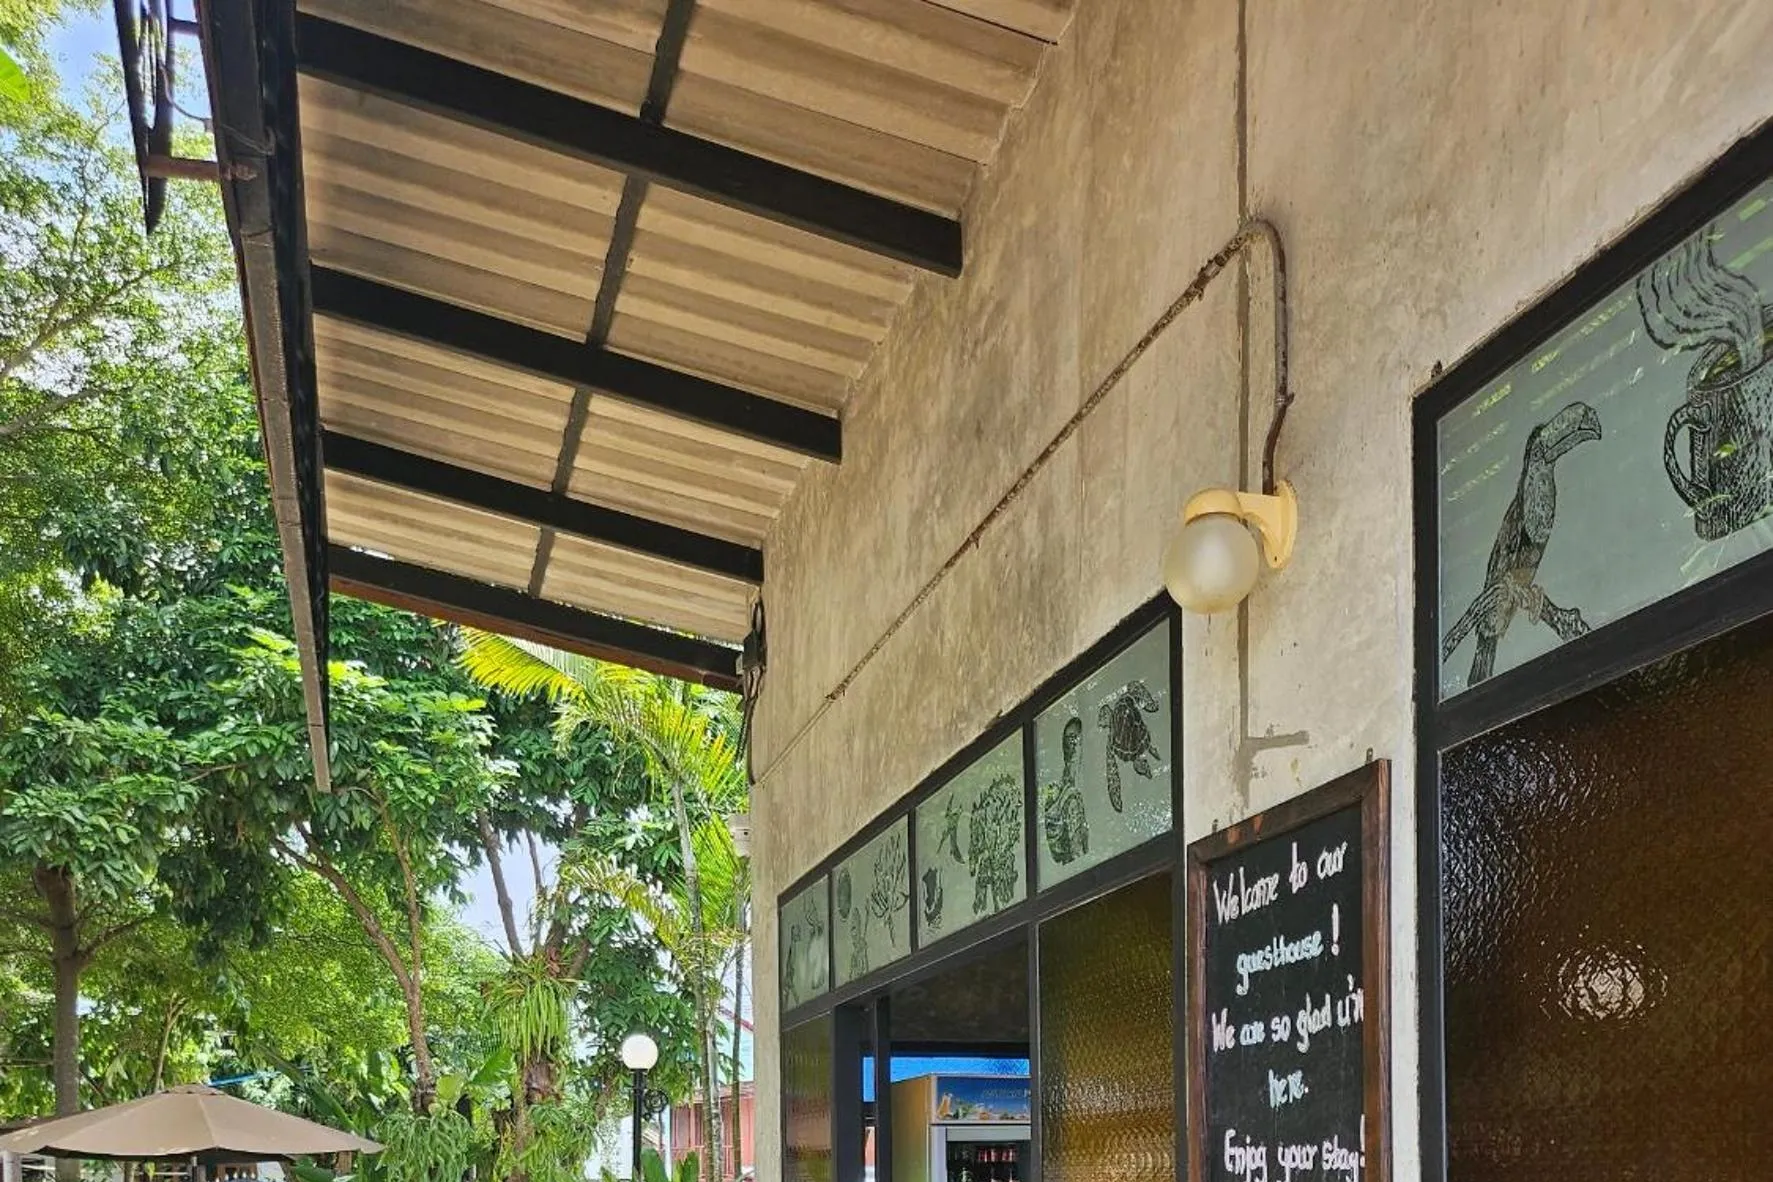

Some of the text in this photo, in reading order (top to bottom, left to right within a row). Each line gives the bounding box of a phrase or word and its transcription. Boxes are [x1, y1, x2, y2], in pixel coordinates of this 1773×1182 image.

[1289, 841, 1308, 894] to
[1317, 841, 1348, 879] our
[1236, 902, 1339, 996] guesthouse !
[1212, 1008, 1235, 1053] We
[1240, 1021, 1265, 1046] are
[1272, 1015, 1291, 1042] so
[1297, 992, 1332, 1053] glad
